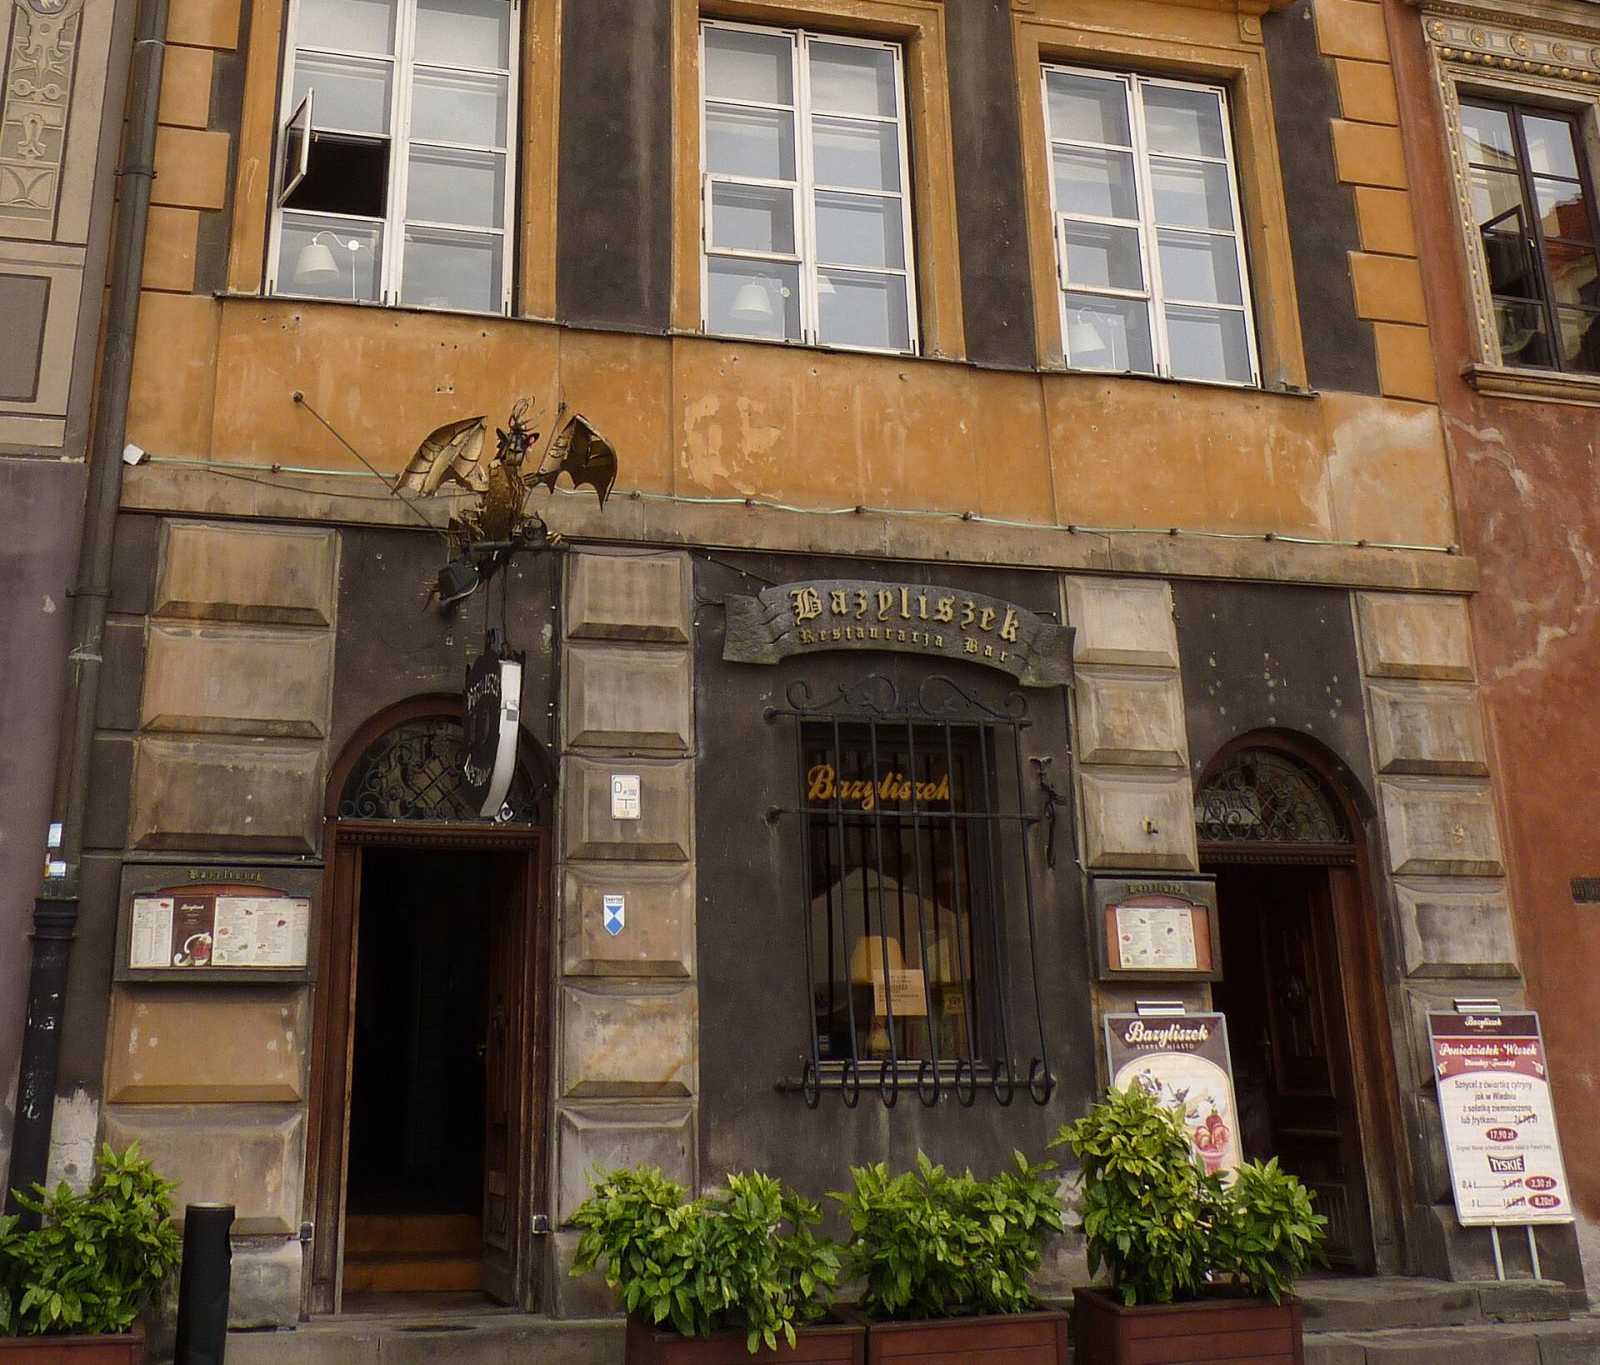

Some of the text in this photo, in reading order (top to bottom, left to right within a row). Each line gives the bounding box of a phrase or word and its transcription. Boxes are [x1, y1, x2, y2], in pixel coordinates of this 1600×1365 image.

[790, 586, 1019, 643] Bazyliszek
[964, 637, 1008, 662] Bar
[1125, 1021, 1208, 1047] Bazyliszek
[1490, 1158, 1524, 1171] TYSKIE
